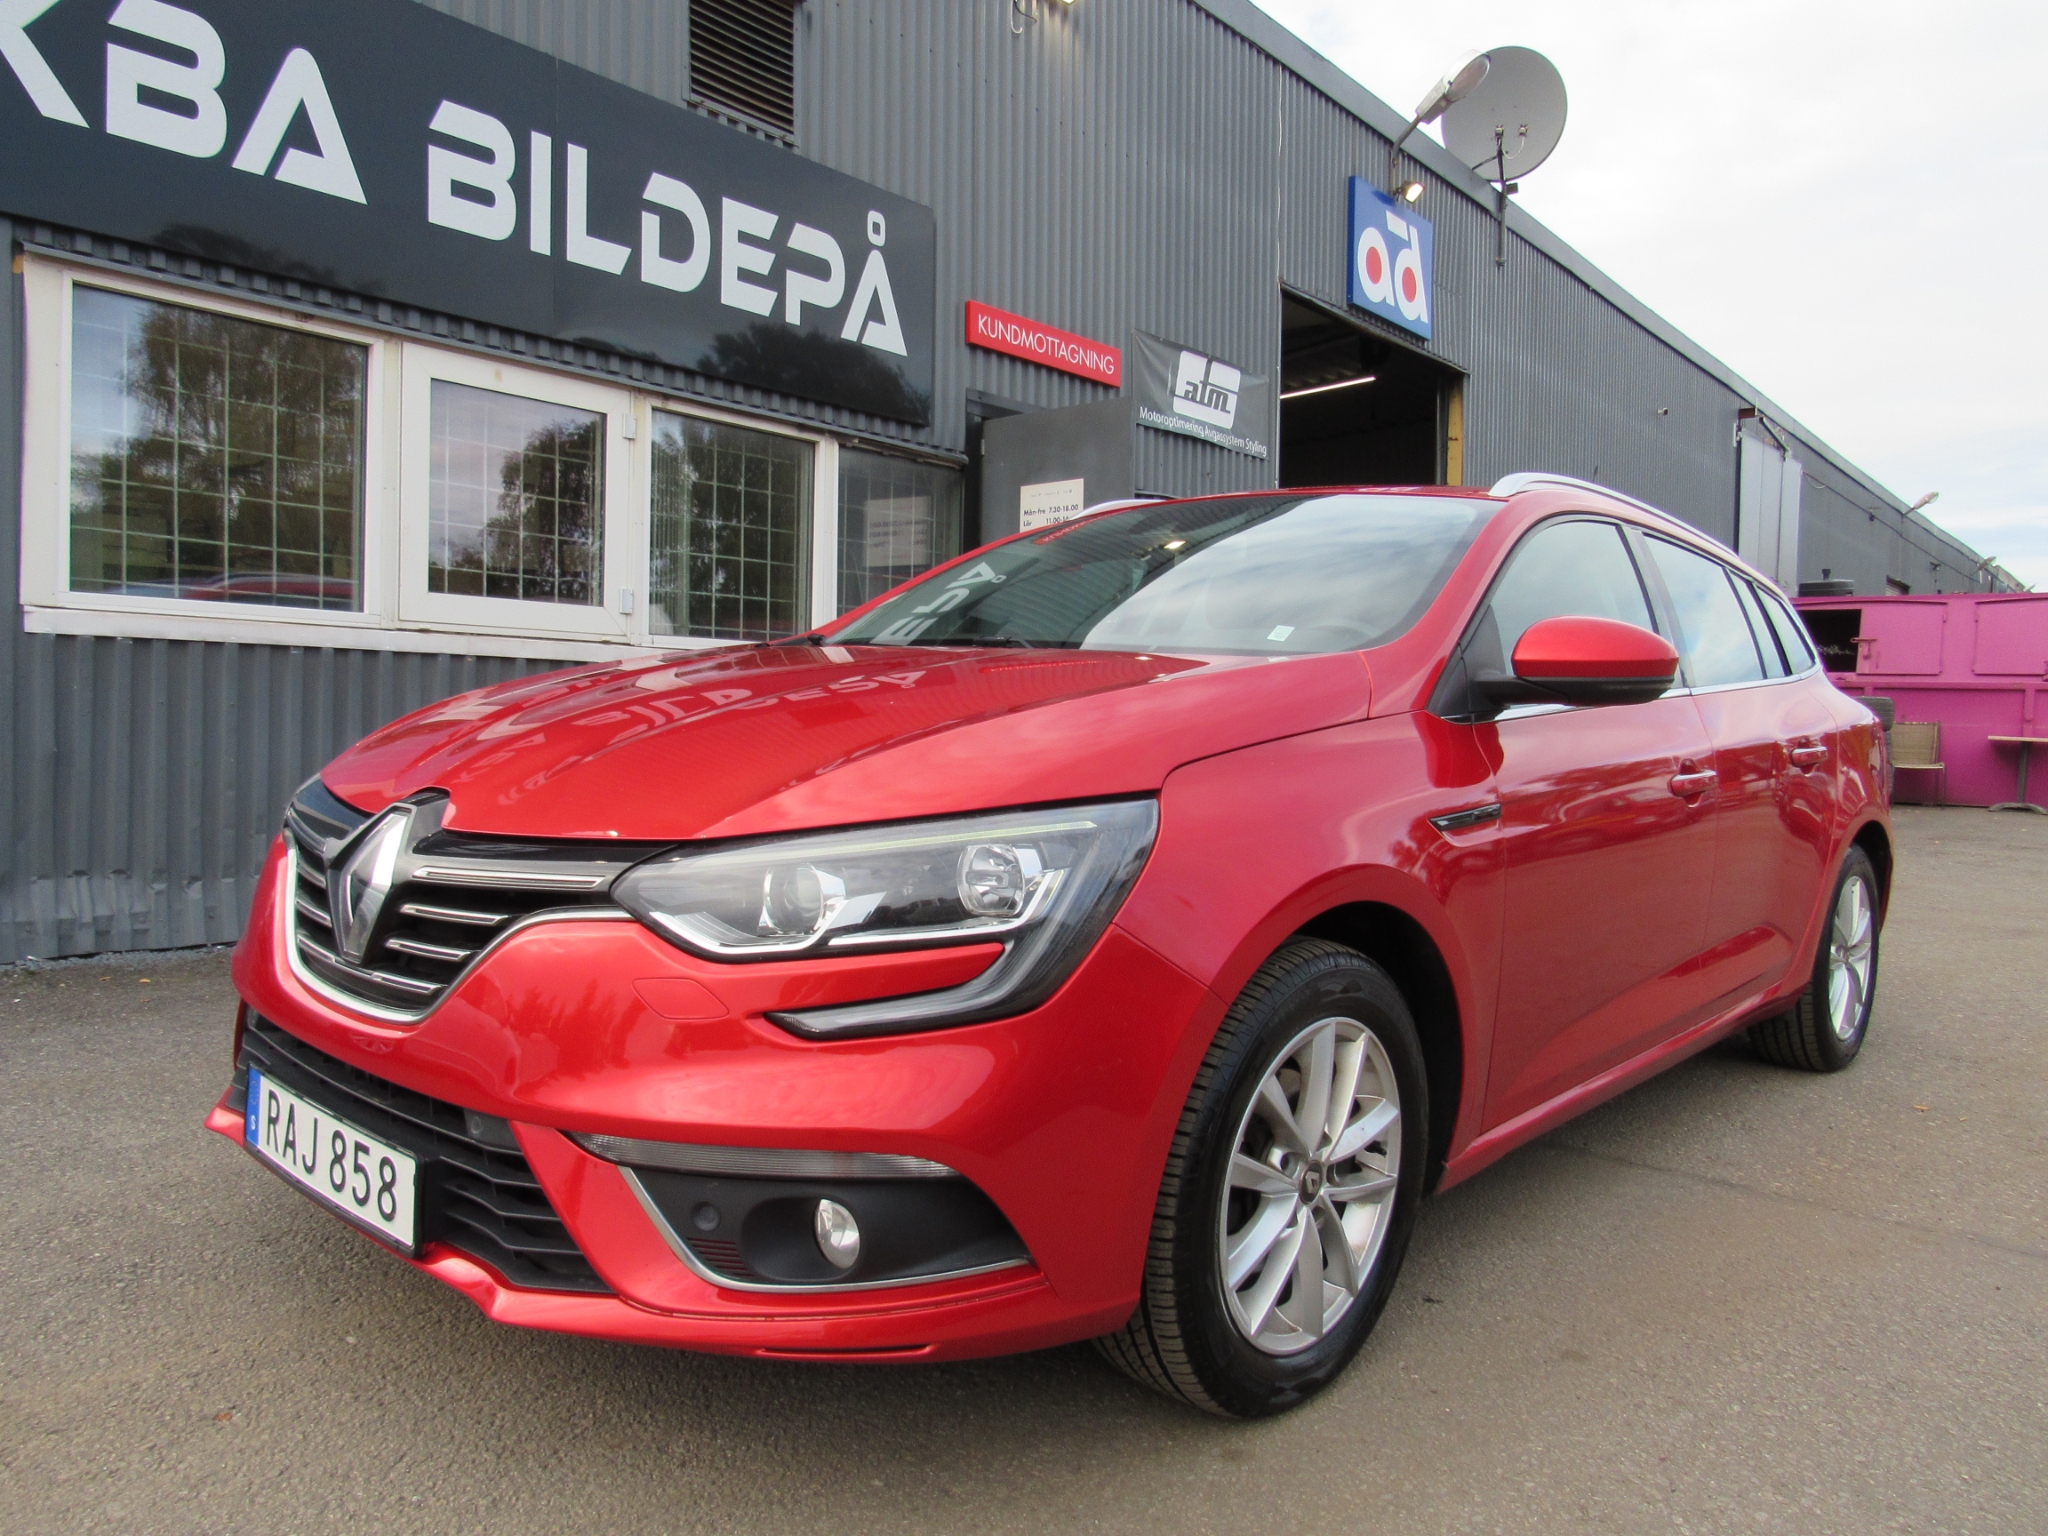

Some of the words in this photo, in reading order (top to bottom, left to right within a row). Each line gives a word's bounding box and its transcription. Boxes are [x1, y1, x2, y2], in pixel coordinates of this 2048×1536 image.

[428, 99, 908, 357] BILDEPÅ
[978, 314, 1115, 375] KUNDMOTTAGNING
[1139, 406, 1205, 438] Motoroptimering
[1204, 426, 1245, 446] Avgassystem
[1245, 438, 1267, 457] Styling
[250, 1114, 257, 1131] S
[266, 1089, 319, 1175] RAJ
[329, 1129, 397, 1222] 858
